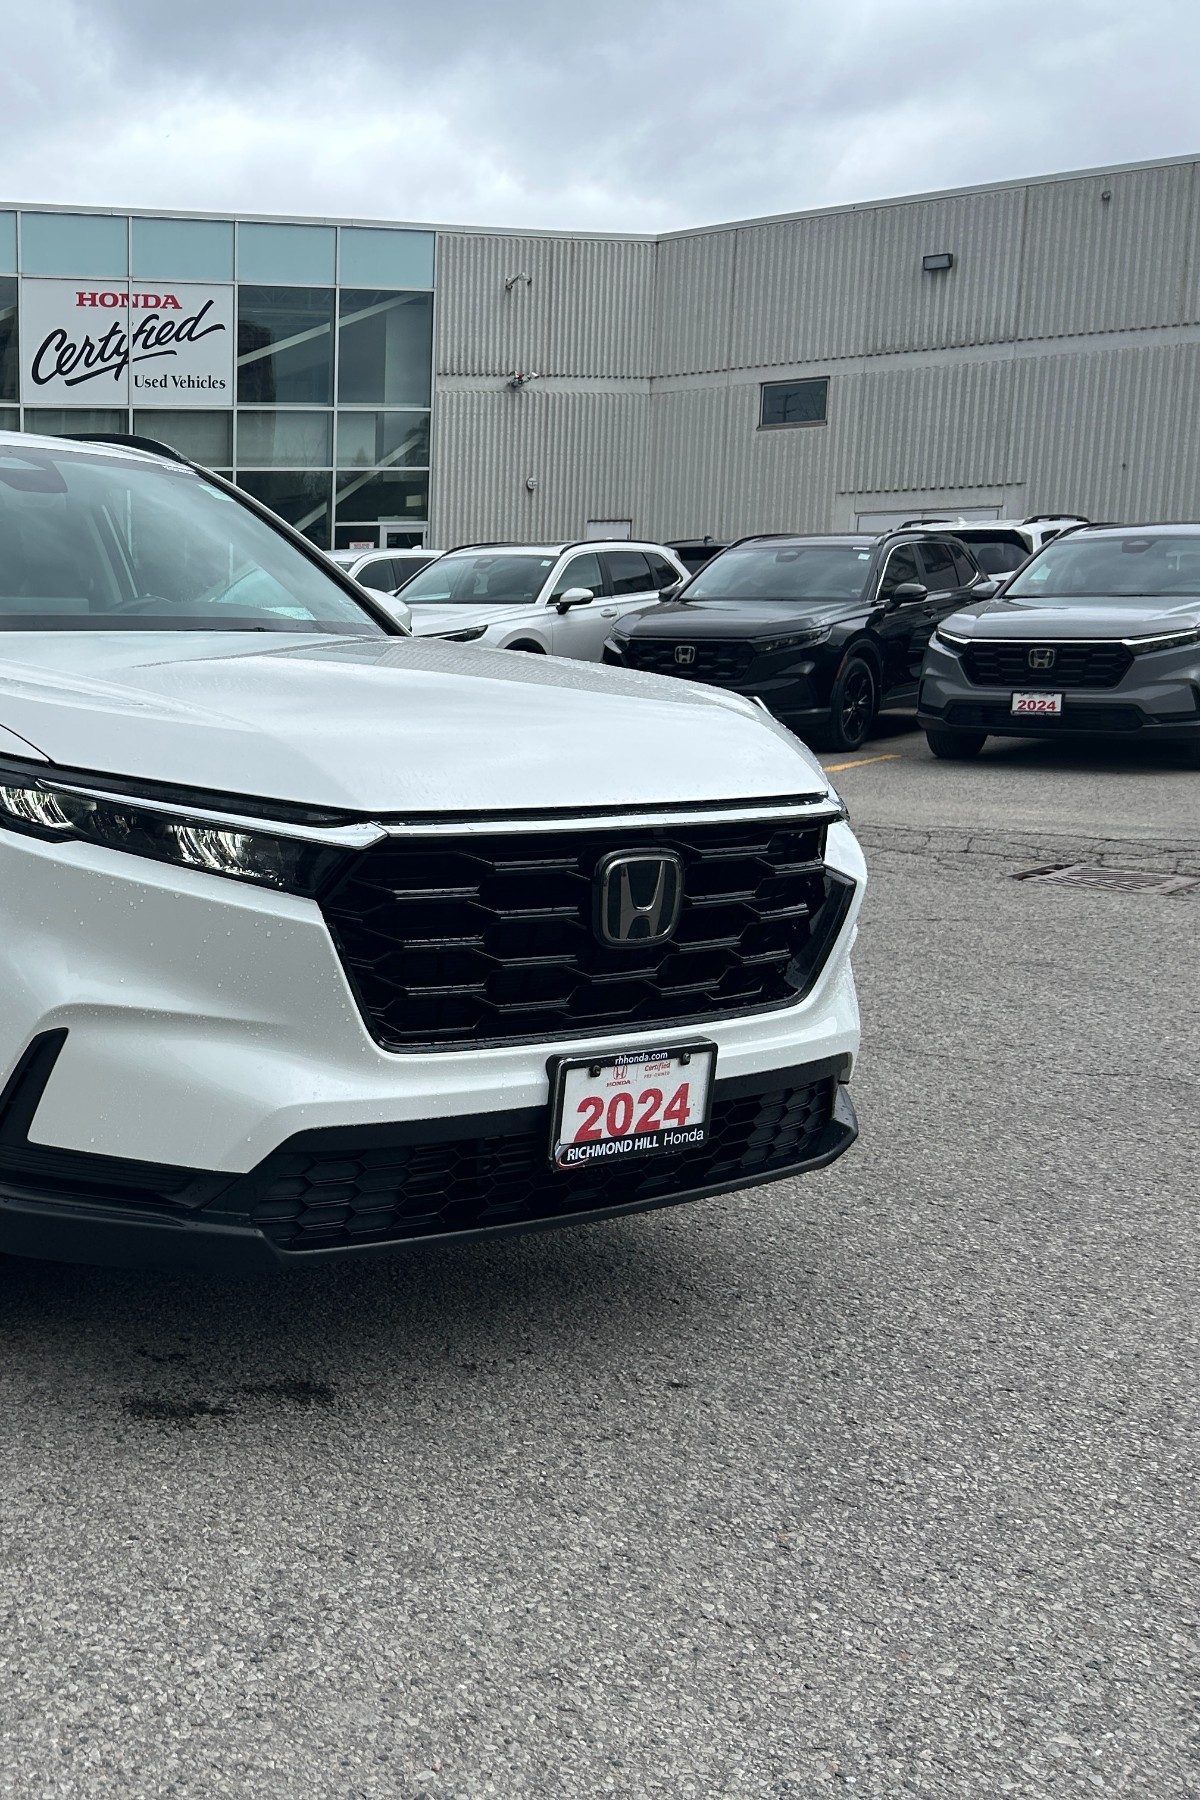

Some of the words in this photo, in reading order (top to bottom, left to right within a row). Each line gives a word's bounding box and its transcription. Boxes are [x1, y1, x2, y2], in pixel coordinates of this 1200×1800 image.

[75, 291, 182, 309] HONDA
[31, 299, 226, 386] Certified
[134, 374, 168, 389] Used
[171, 374, 226, 389] Vehicles
[1017, 700, 1056, 711] 2024
[614, 1052, 668, 1065] rhhonda.com
[574, 1082, 691, 1143] 2024
[567, 1139, 633, 1161] RICHMOND
[634, 1135, 659, 1151] HILL
[663, 1128, 704, 1146] Honda
